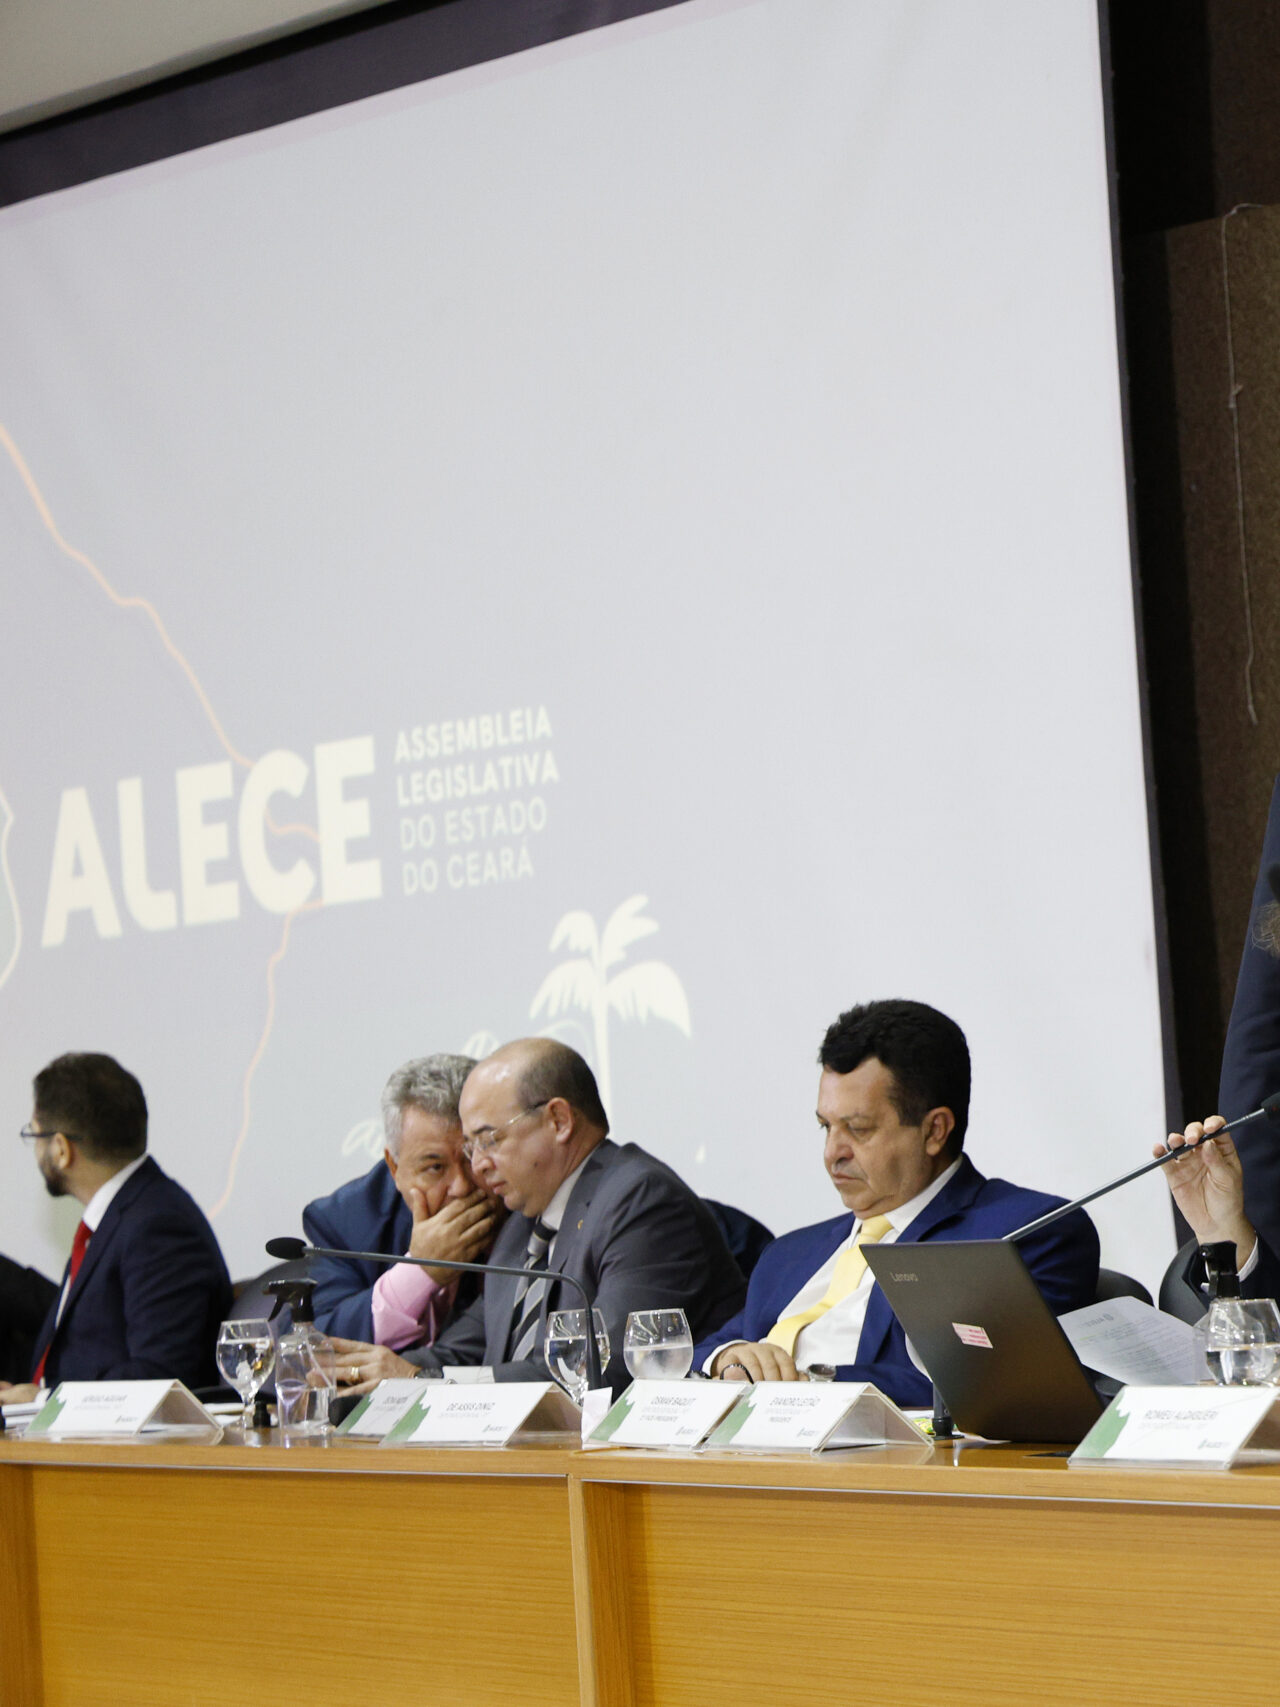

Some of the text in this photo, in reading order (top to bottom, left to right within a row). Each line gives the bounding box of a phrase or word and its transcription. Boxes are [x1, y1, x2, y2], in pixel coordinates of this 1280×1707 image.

[394, 703, 553, 765] ASSEMBLEIA
[396, 749, 560, 808] LEGISLATIVA
[41, 735, 383, 949] ALECE
[401, 795, 548, 851] DO ESTADO
[402, 834, 535, 896] DO CEARÁ
